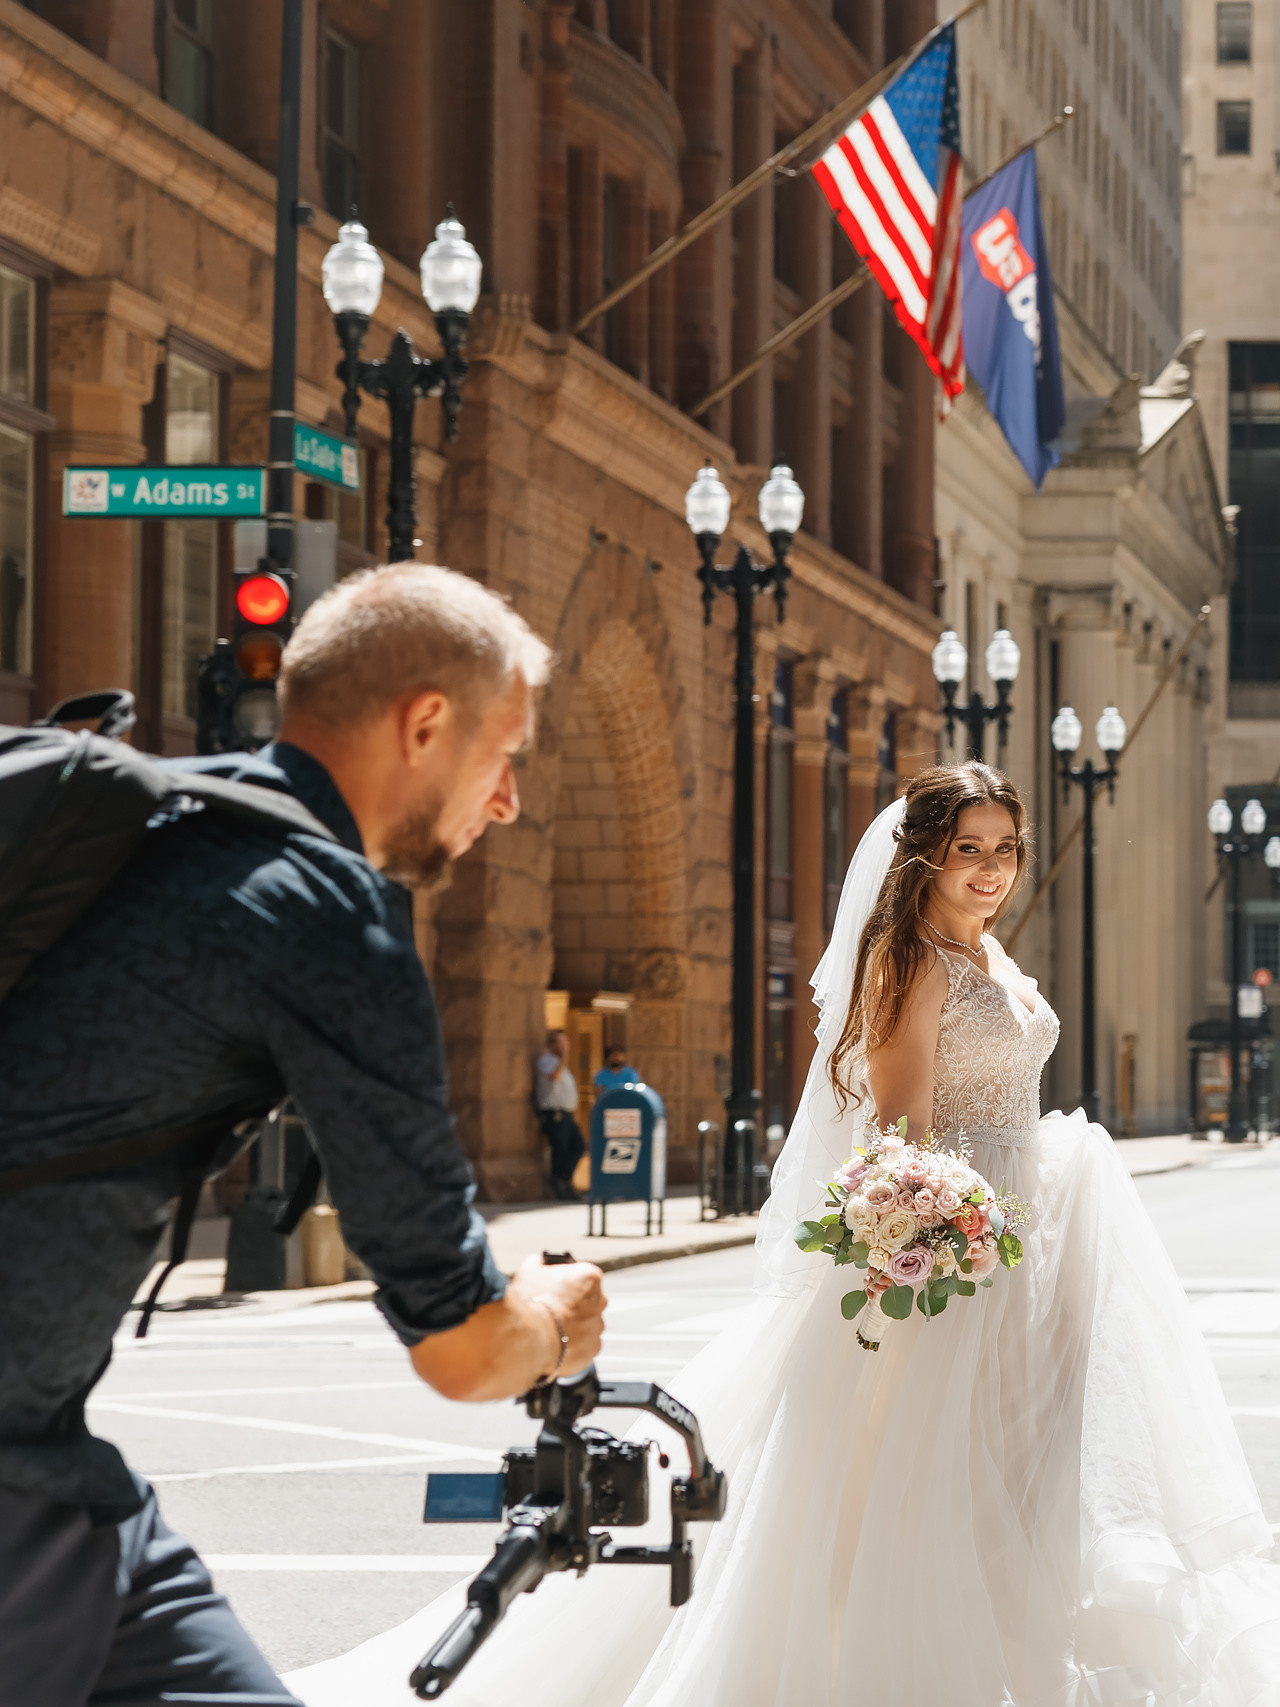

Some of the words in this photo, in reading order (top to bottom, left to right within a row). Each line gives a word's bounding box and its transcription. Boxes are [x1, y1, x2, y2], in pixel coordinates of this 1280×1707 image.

[110, 483, 126, 498] W
[133, 475, 229, 506] Adams
[236, 482, 256, 499] St
